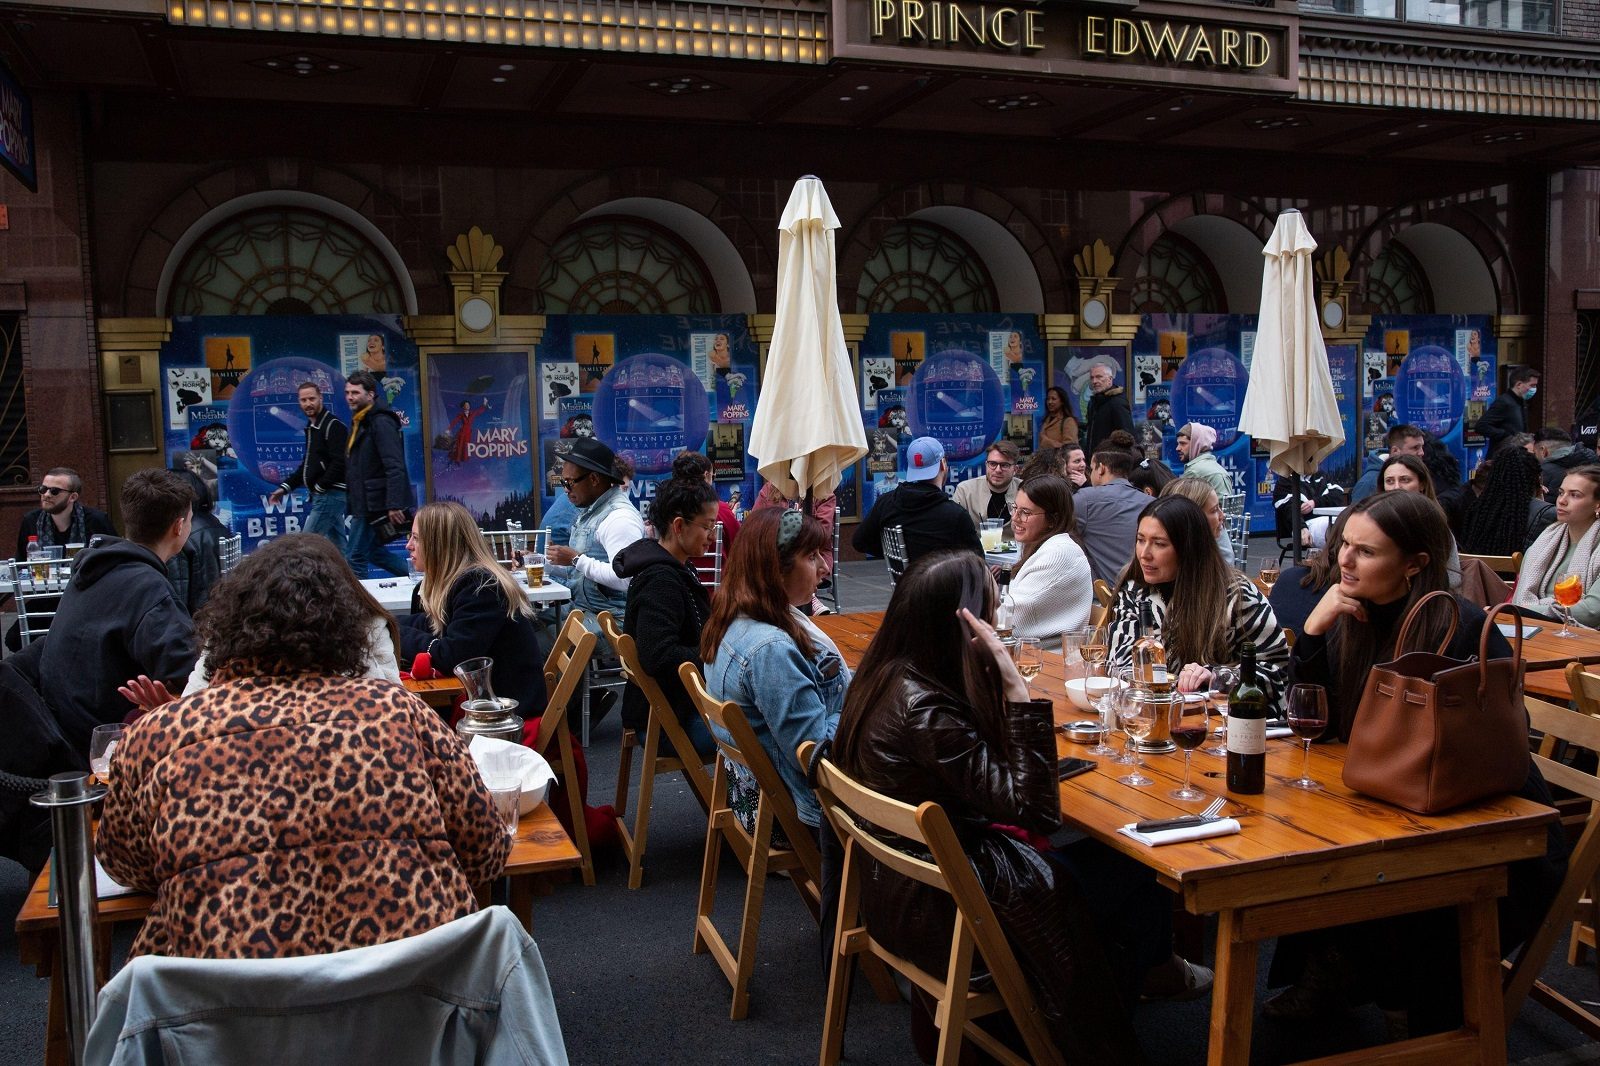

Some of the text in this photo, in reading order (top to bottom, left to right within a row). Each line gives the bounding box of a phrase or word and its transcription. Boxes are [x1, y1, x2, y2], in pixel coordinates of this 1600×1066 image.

[870, 0, 1271, 68] PRINCE EDWARD
[253, 394, 332, 403] DELFT
[1020, 396, 1035, 404] MARY
[727, 404, 746, 412] MARY
[1016, 402, 1038, 410] POPPINS
[722, 410, 750, 419] POPPINS
[476, 427, 518, 443] MARY
[467, 440, 528, 458] POPPINS
[1258, 482, 1271, 494] LIFE
[247, 517, 278, 538] BE
